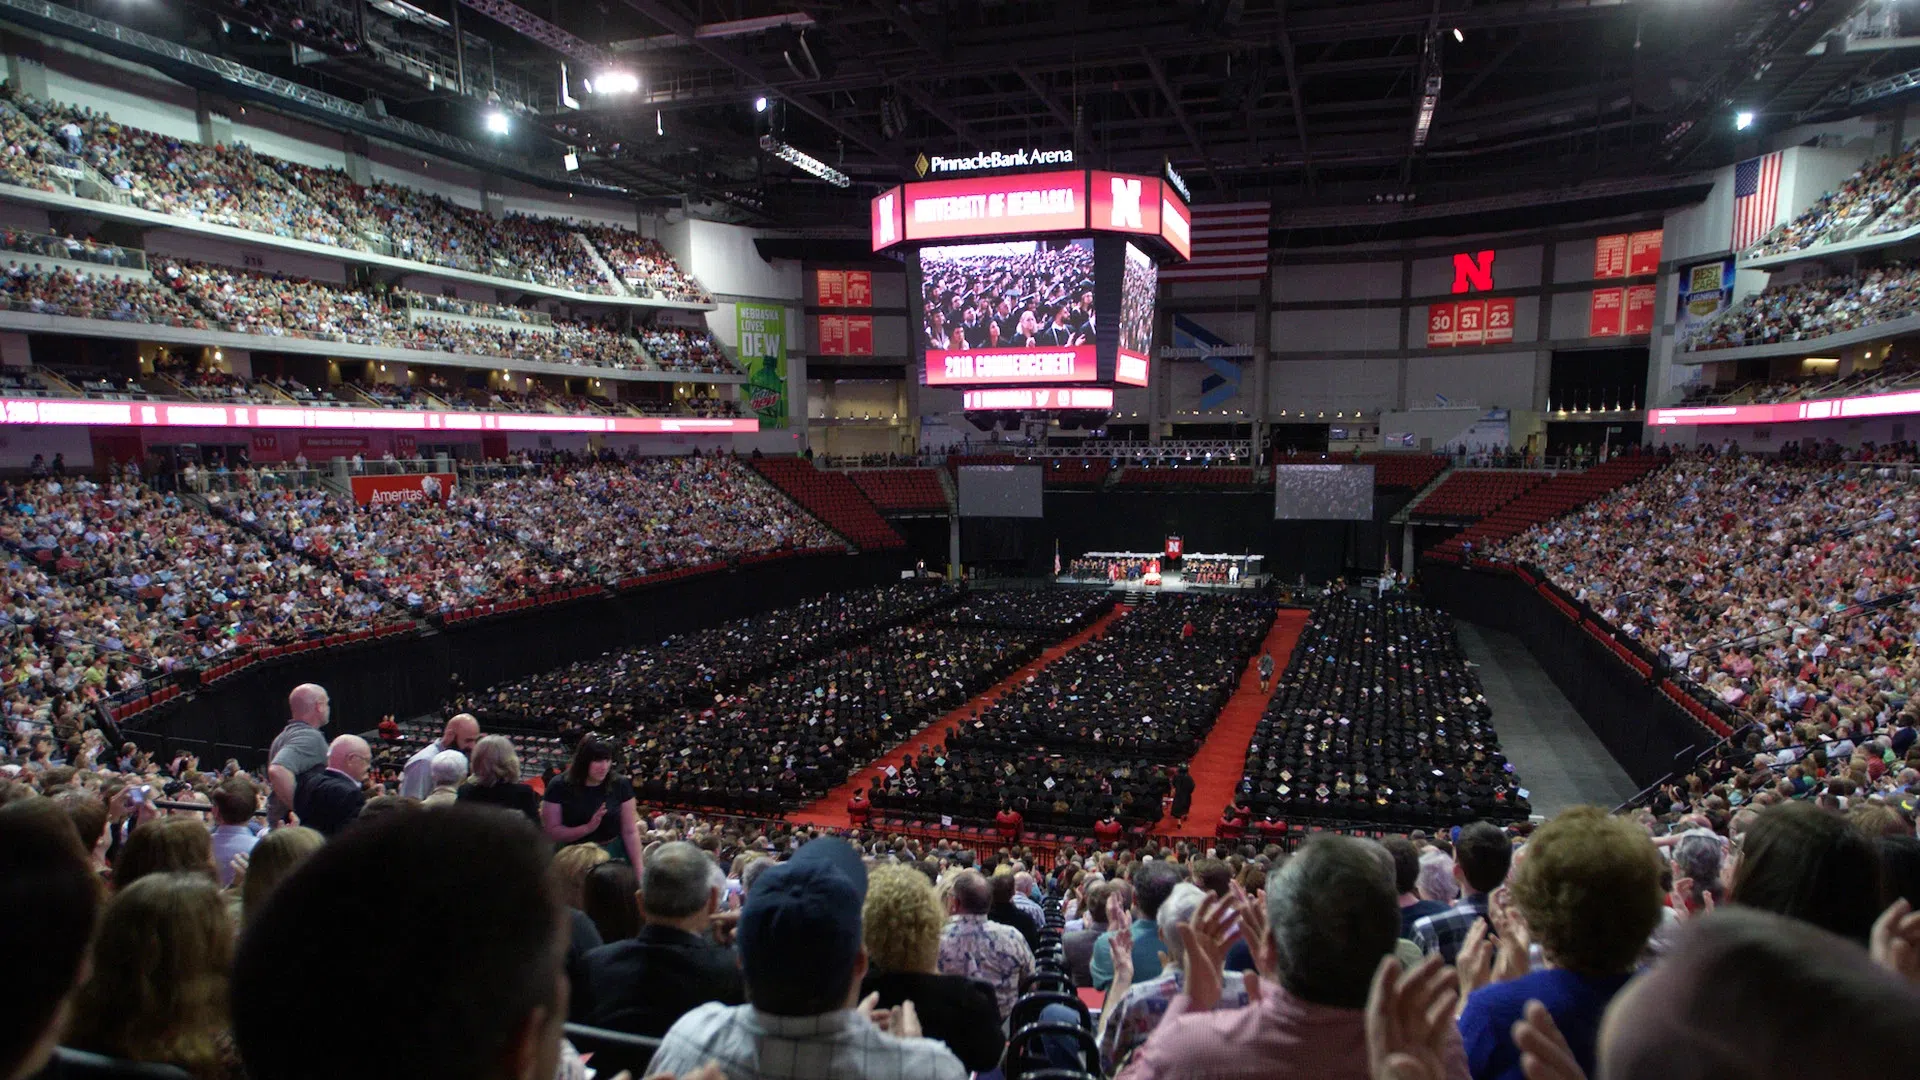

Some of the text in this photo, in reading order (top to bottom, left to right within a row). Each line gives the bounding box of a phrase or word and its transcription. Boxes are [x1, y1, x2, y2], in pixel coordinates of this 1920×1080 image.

[1029, 148, 1073, 165] Arena
[914, 188, 1075, 223] UNIVERSITY OF NEBRASKA
[1110, 177, 1143, 229] N
[1451, 249, 1495, 295] N
[1693, 264, 1721, 282] BEST
[1692, 277, 1720, 292] CARS
[740, 307, 780, 321] NEBRASKA
[1461, 313, 1478, 329] 51
[1489, 311, 1510, 327] 23
[741, 319, 765, 333] LOVES
[1431, 315, 1451, 331] 30
[741, 331, 781, 358] DEW
[1161, 343, 1254, 360] Bryan Health
[975, 351, 1076, 377] COMMENCEMENT
[371, 487, 424, 503] Ameritas
[1168, 541, 1180, 553] N
